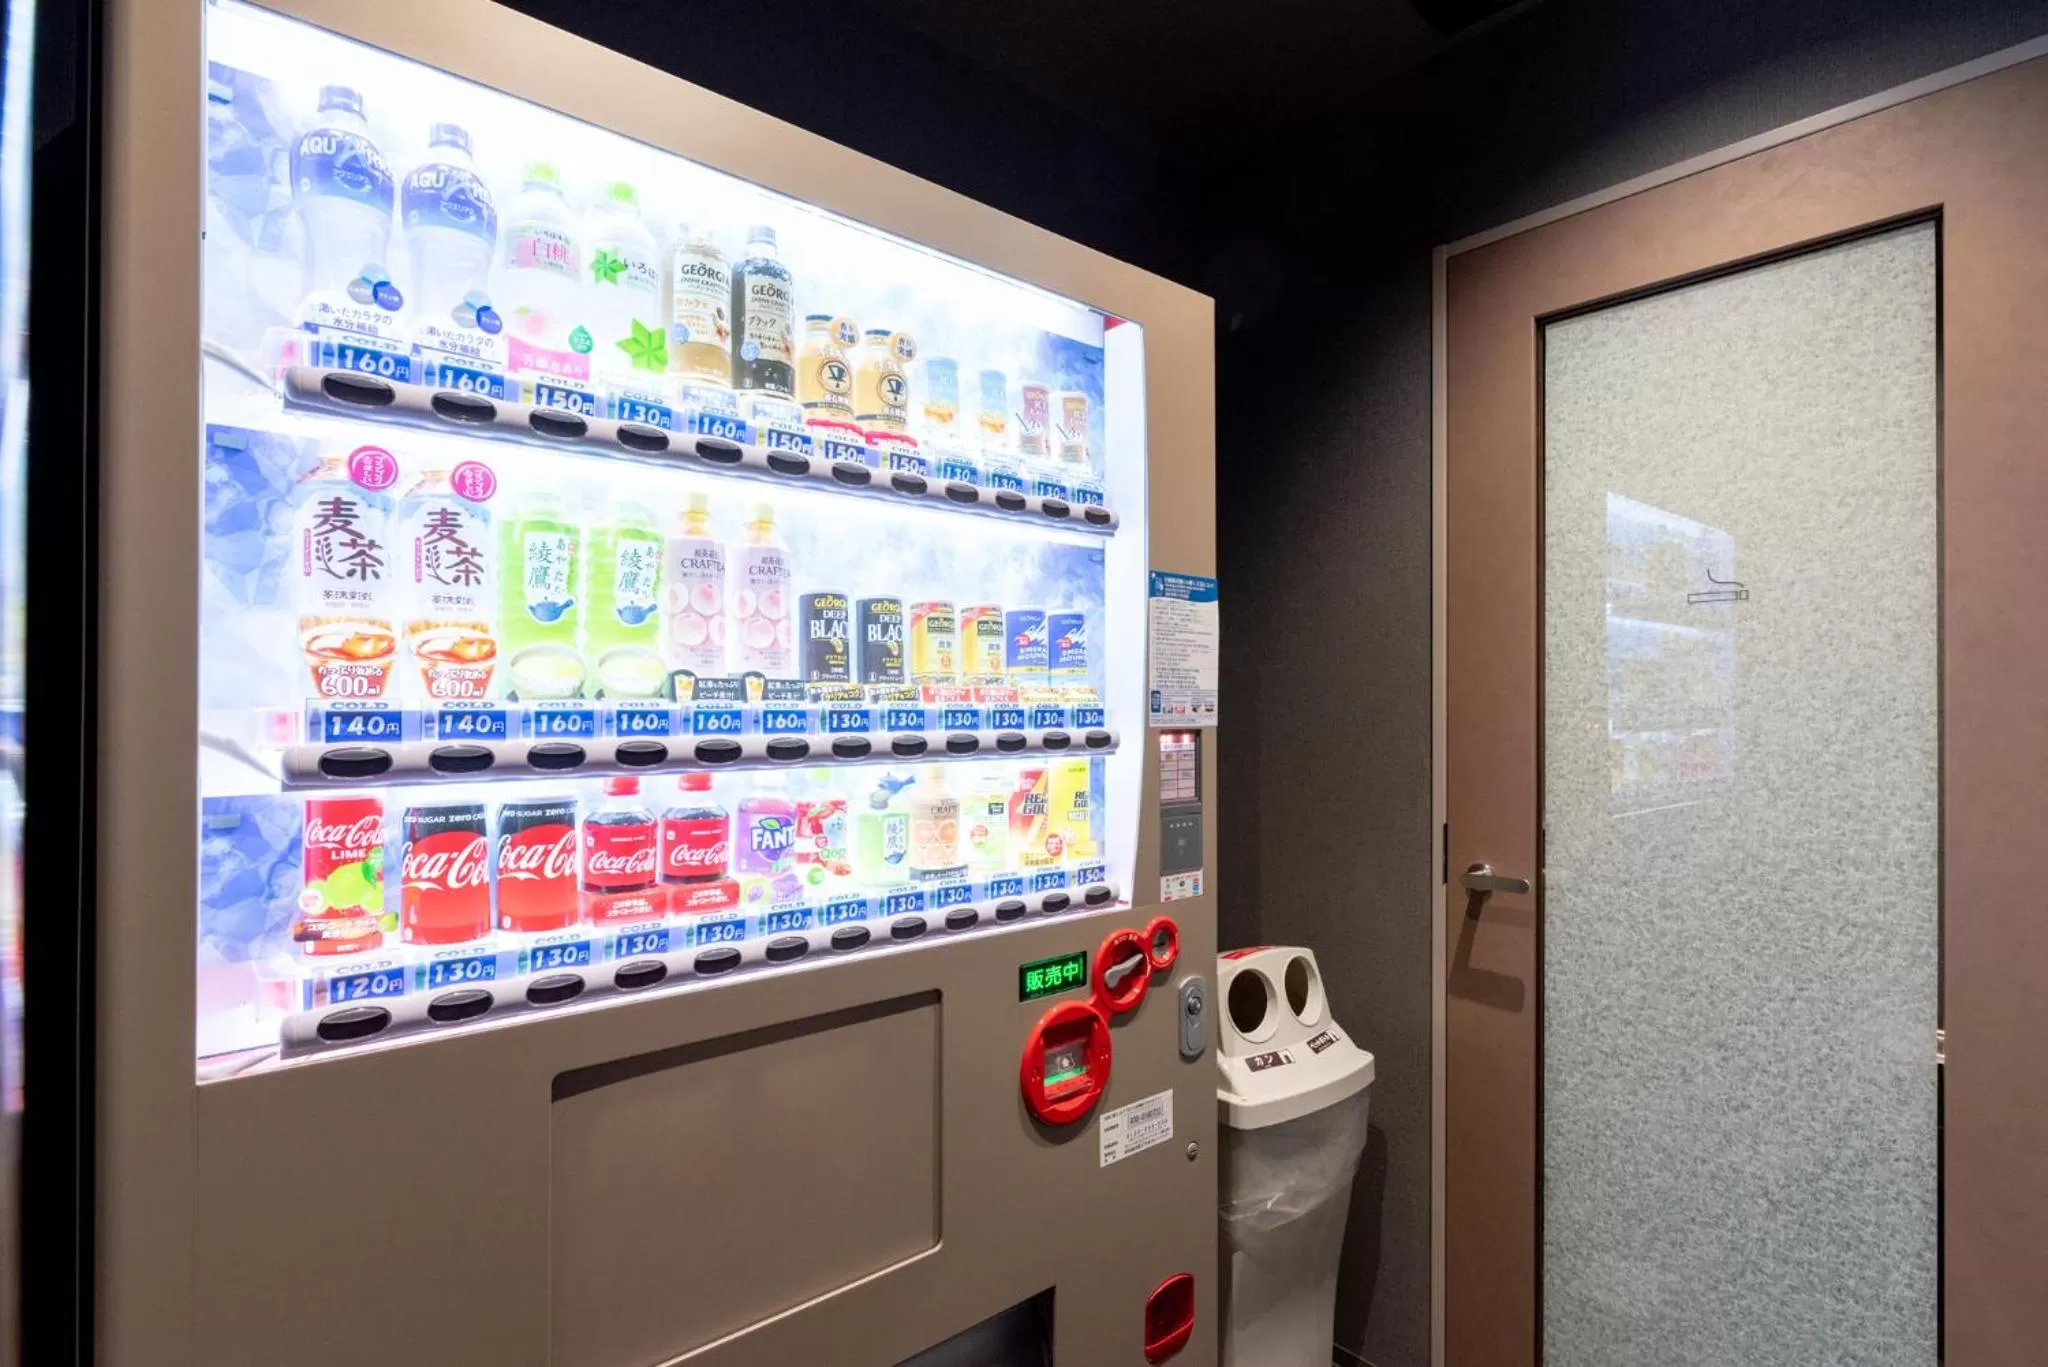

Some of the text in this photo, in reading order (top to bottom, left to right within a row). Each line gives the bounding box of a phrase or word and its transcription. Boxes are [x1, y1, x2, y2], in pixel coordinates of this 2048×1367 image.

[343, 335, 399, 350] COLD
[345, 350, 409, 382] 160円
[443, 356, 494, 371] COLD
[446, 370, 503, 400] 160円
[540, 387, 594, 414] 150円
[623, 402, 670, 430] 130円
[703, 417, 745, 442] 160円
[828, 443, 865, 464] 150円
[313, 497, 384, 581] 麦茶
[423, 508, 485, 586] 麦茶
[332, 716, 399, 735] 140円
[444, 715, 505, 733] 140円
[541, 715, 593, 732] 160円
[622, 714, 668, 730] 160円
[699, 714, 741, 729] 160円
[767, 714, 806, 728] 160円
[833, 714, 869, 728] 130円
[331, 850, 367, 860] LIME
[829, 904, 867, 921] 130円
[701, 924, 744, 942] 130円
[434, 947, 486, 959] COLD
[621, 935, 669, 955] 130円
[536, 947, 590, 968] 130円
[336, 960, 392, 975] COLD
[435, 961, 494, 983] 130円
[1026, 961, 1079, 992] 販売中
[337, 975, 403, 999] 120円
[1254, 1054, 1273, 1067] カン
